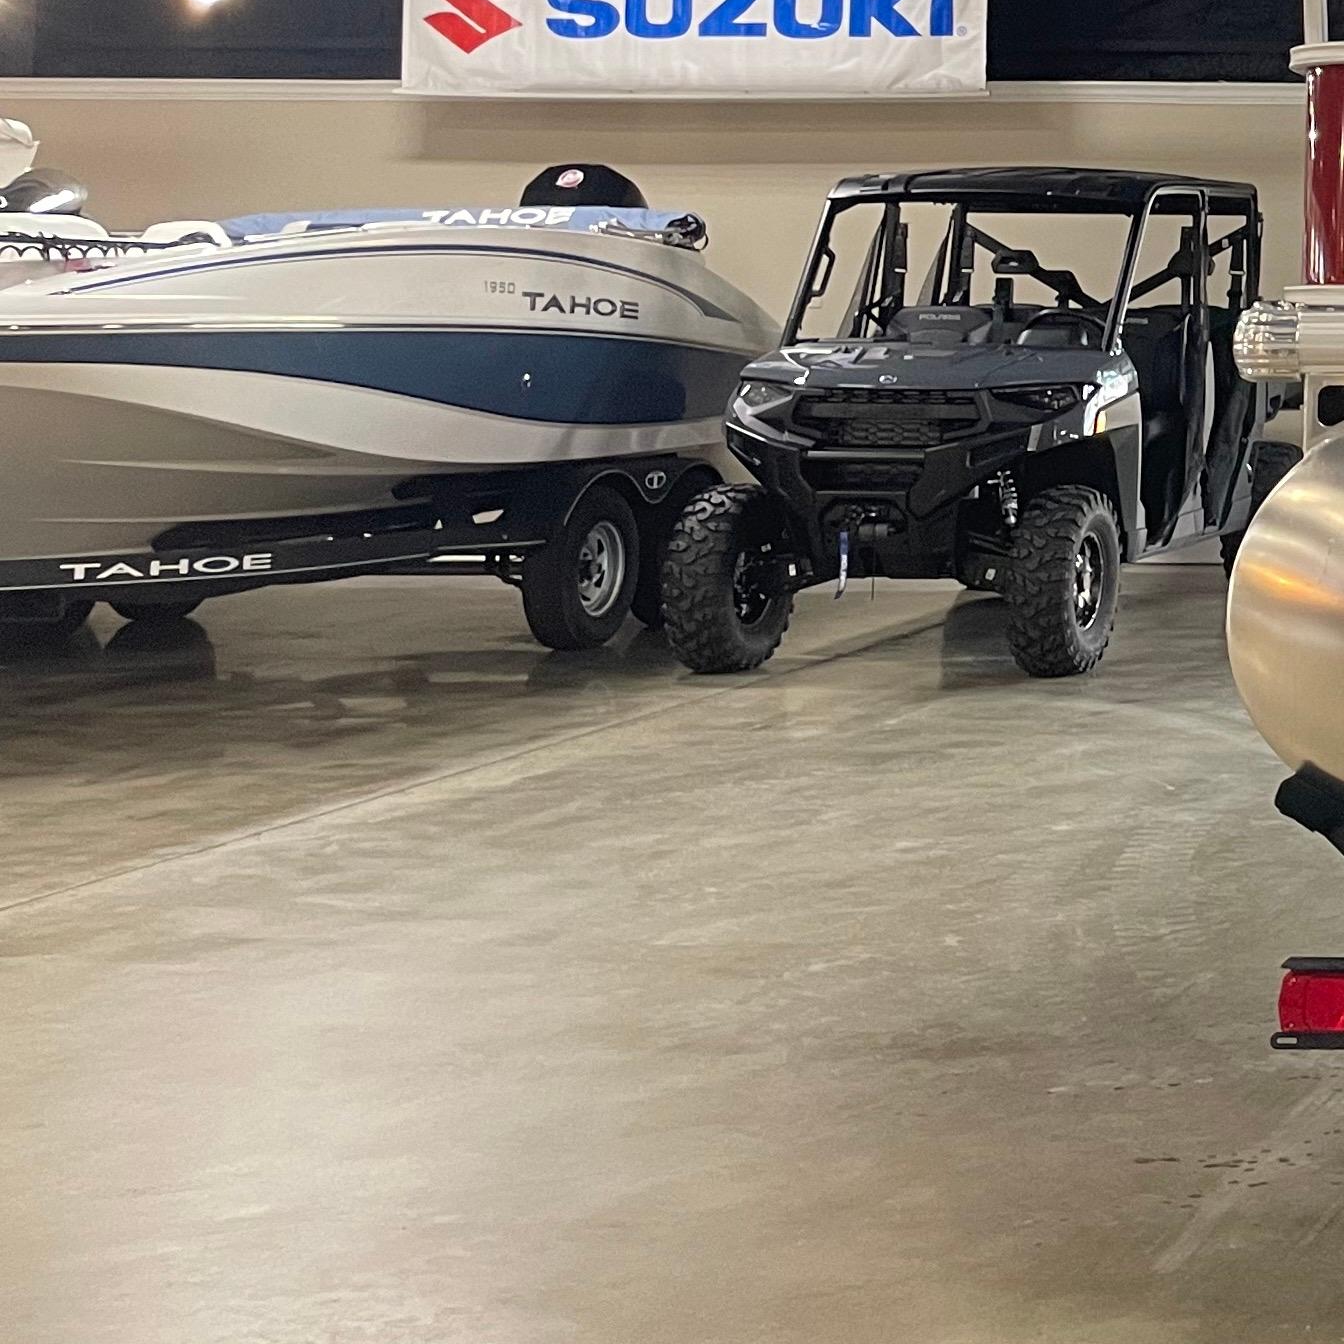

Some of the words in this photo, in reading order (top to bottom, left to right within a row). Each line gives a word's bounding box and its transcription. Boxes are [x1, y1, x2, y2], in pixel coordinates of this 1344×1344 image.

[421, 206, 576, 225] TAHOE
[484, 280, 516, 294] 1950
[521, 291, 640, 320] TAHOE
[59, 553, 272, 580] TAHOE
